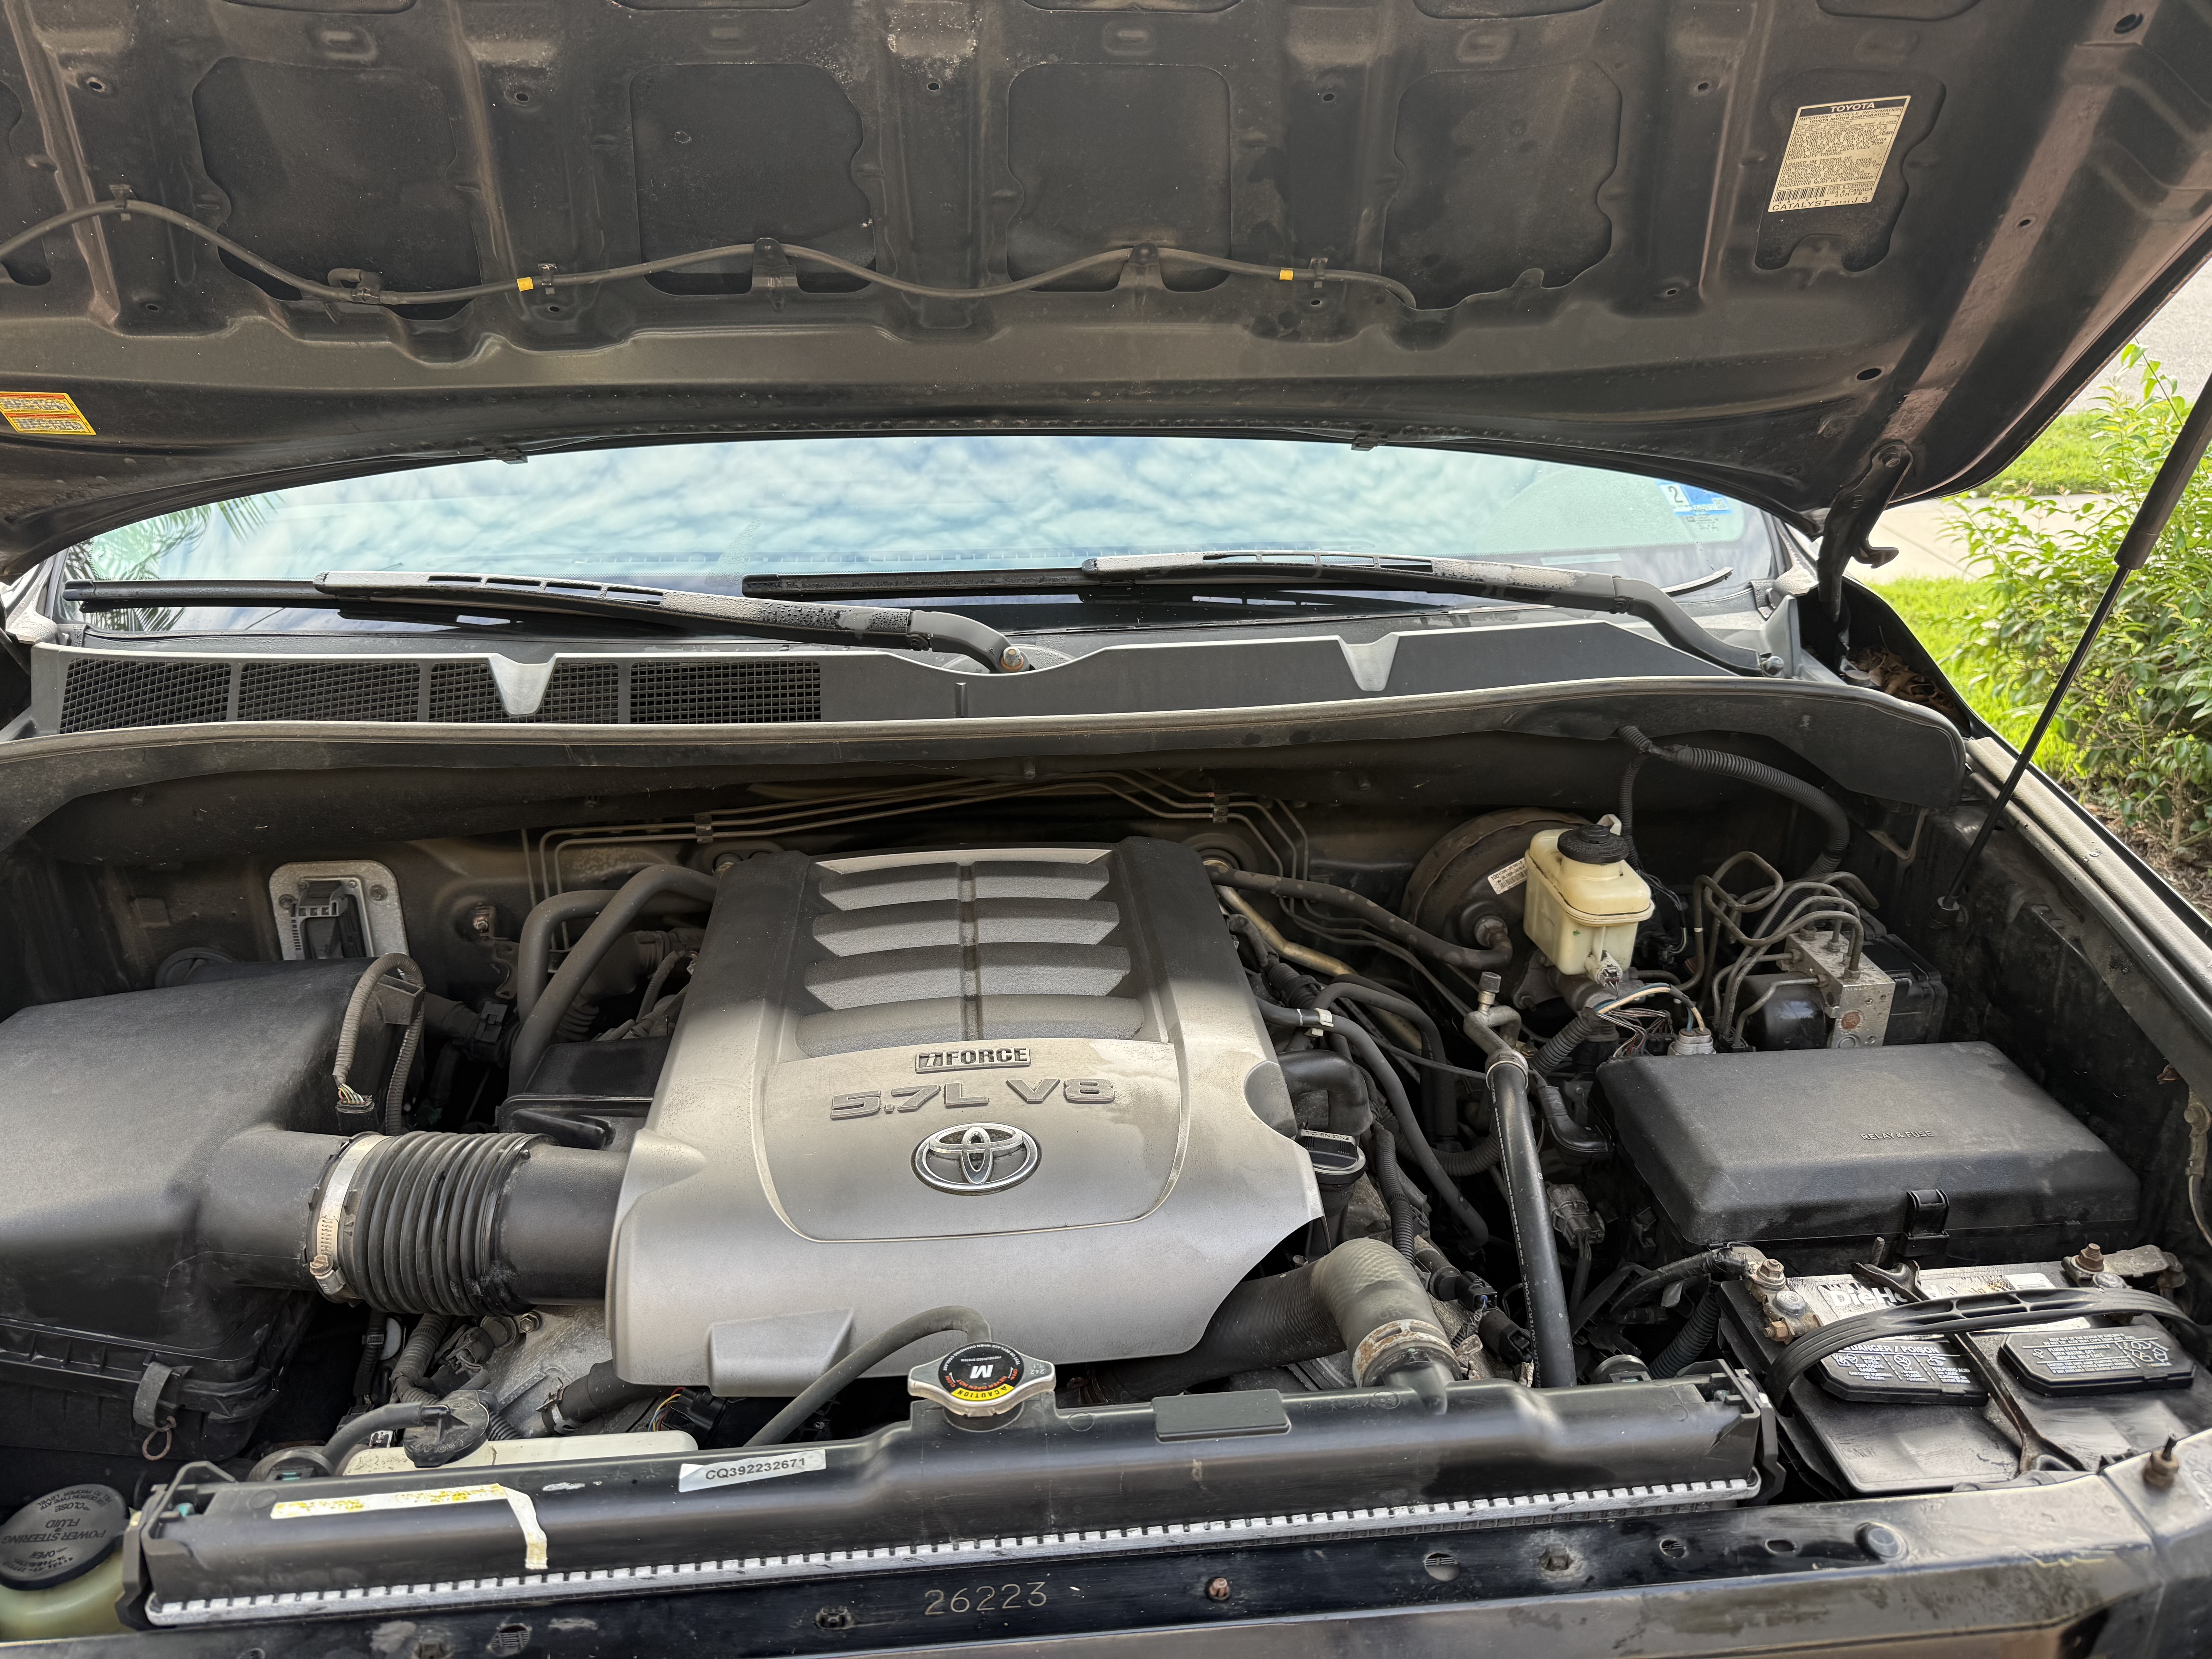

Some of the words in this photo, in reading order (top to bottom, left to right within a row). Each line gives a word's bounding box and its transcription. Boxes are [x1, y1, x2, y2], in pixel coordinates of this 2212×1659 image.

[1829, 102, 1876, 112] TOYOTA
[1772, 199, 1829, 210] CATALYST
[1668, 486, 1683, 503] 2
[830, 1082, 990, 1120] 5.7L
[1006, 1078, 1115, 1103] V8
[953, 1345, 976, 1355] CHANGING
[991, 1344, 1011, 1353] REPLACE
[942, 1355, 954, 1371] COOLANT
[944, 1375, 956, 1388] CLOSE
[955, 1379, 969, 1388] HOT
[988, 1376, 1007, 1388] NEVER
[957, 1389, 1000, 1398] CAUTION
[706, 1458, 805, 1480] CQ392232671
[54, 1502, 85, 1513] CLOSE
[45, 1518, 81, 1528] FLUID
[1, 1533, 60, 1544] STEERING
[61, 1529, 106, 1540] POWER
[29, 1550, 55, 1559] OPEN
[924, 1581, 1047, 1616] 26223
